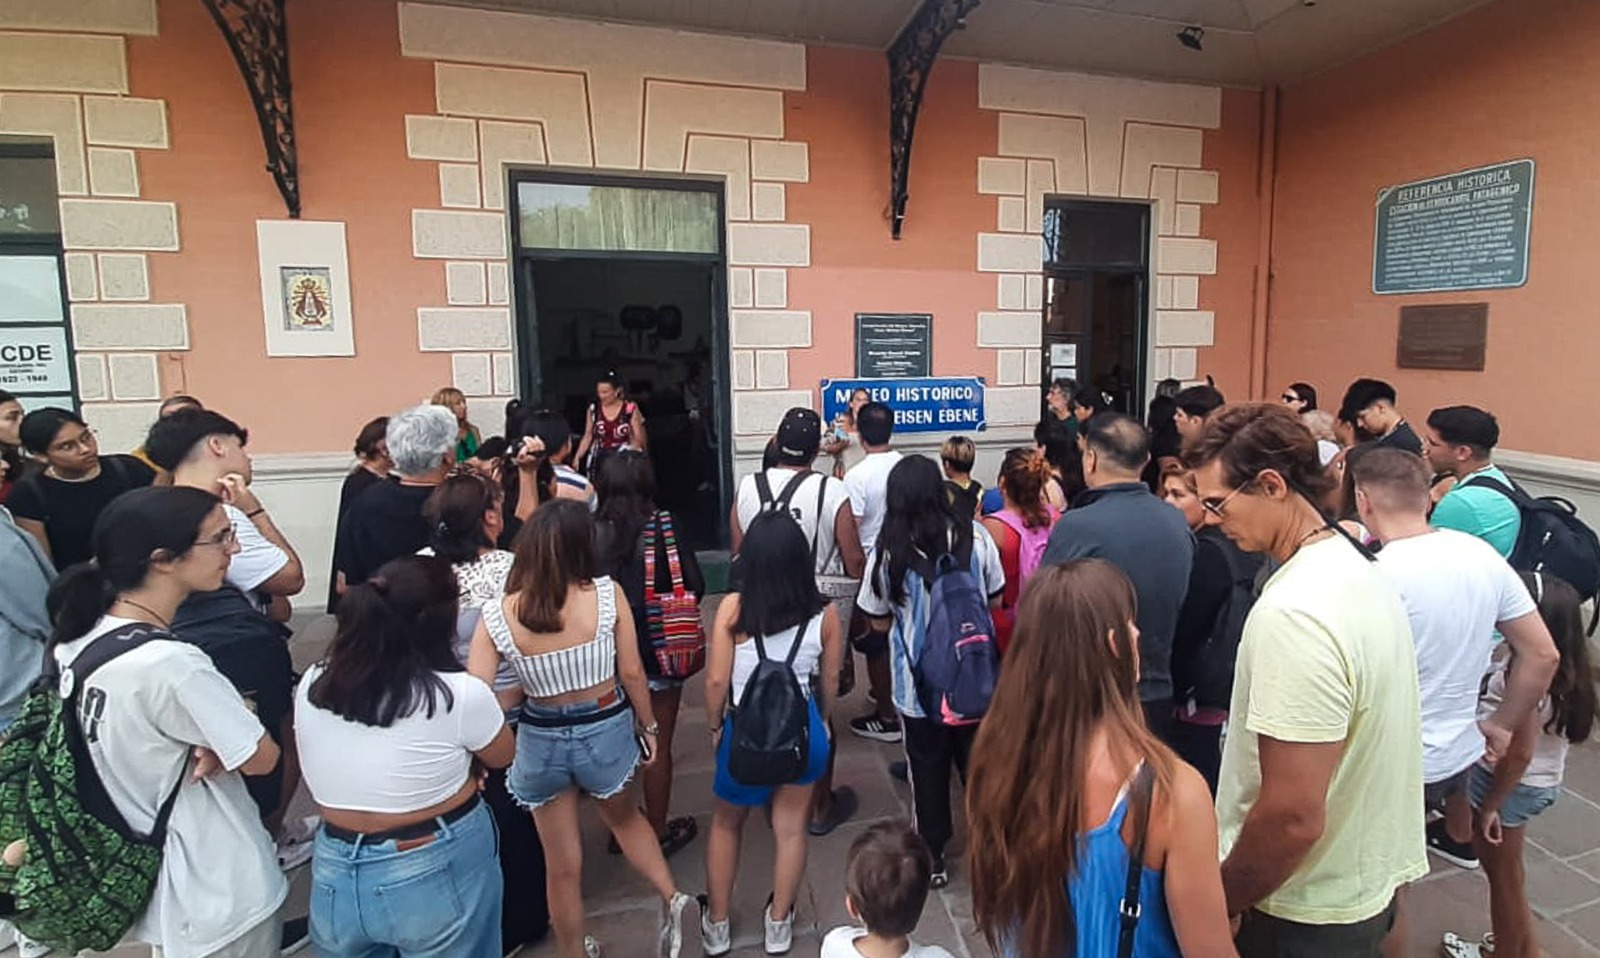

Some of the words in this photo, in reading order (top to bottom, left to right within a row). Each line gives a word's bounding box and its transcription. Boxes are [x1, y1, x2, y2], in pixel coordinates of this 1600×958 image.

[1398, 181, 1453, 202] REFERENCIA
[1458, 169, 1511, 190] HISTORICA
[835, 387, 890, 403] MEO
[896, 386, 973, 401] HISTORICO
[894, 410, 932, 424] EISEN
[938, 407, 979, 423] EBENE
